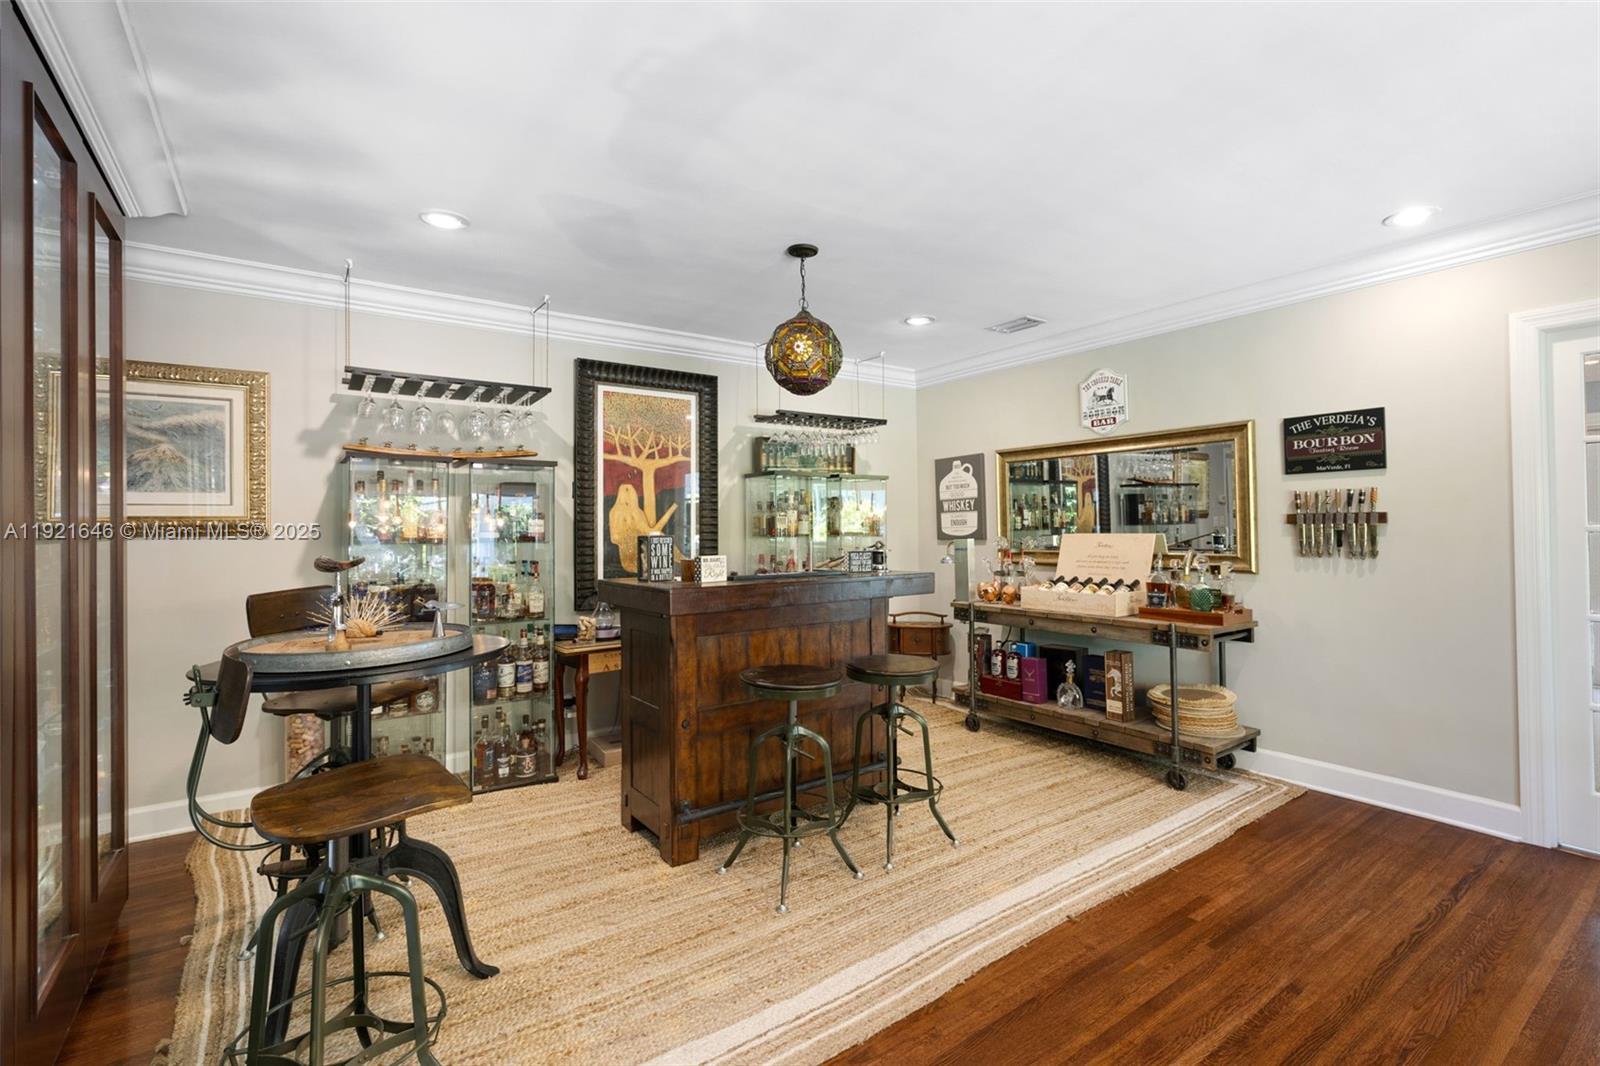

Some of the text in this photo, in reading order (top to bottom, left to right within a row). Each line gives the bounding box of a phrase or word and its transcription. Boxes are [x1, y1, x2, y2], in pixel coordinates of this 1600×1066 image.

[1093, 418, 1114, 427] BAR
[1289, 414, 1377, 434] THE VERDEJA'S
[1293, 433, 1377, 450] BOURBON
[943, 499, 975, 512] WHISKEY
[650, 544, 672, 557] SOME
[650, 556, 672, 569] WINE
